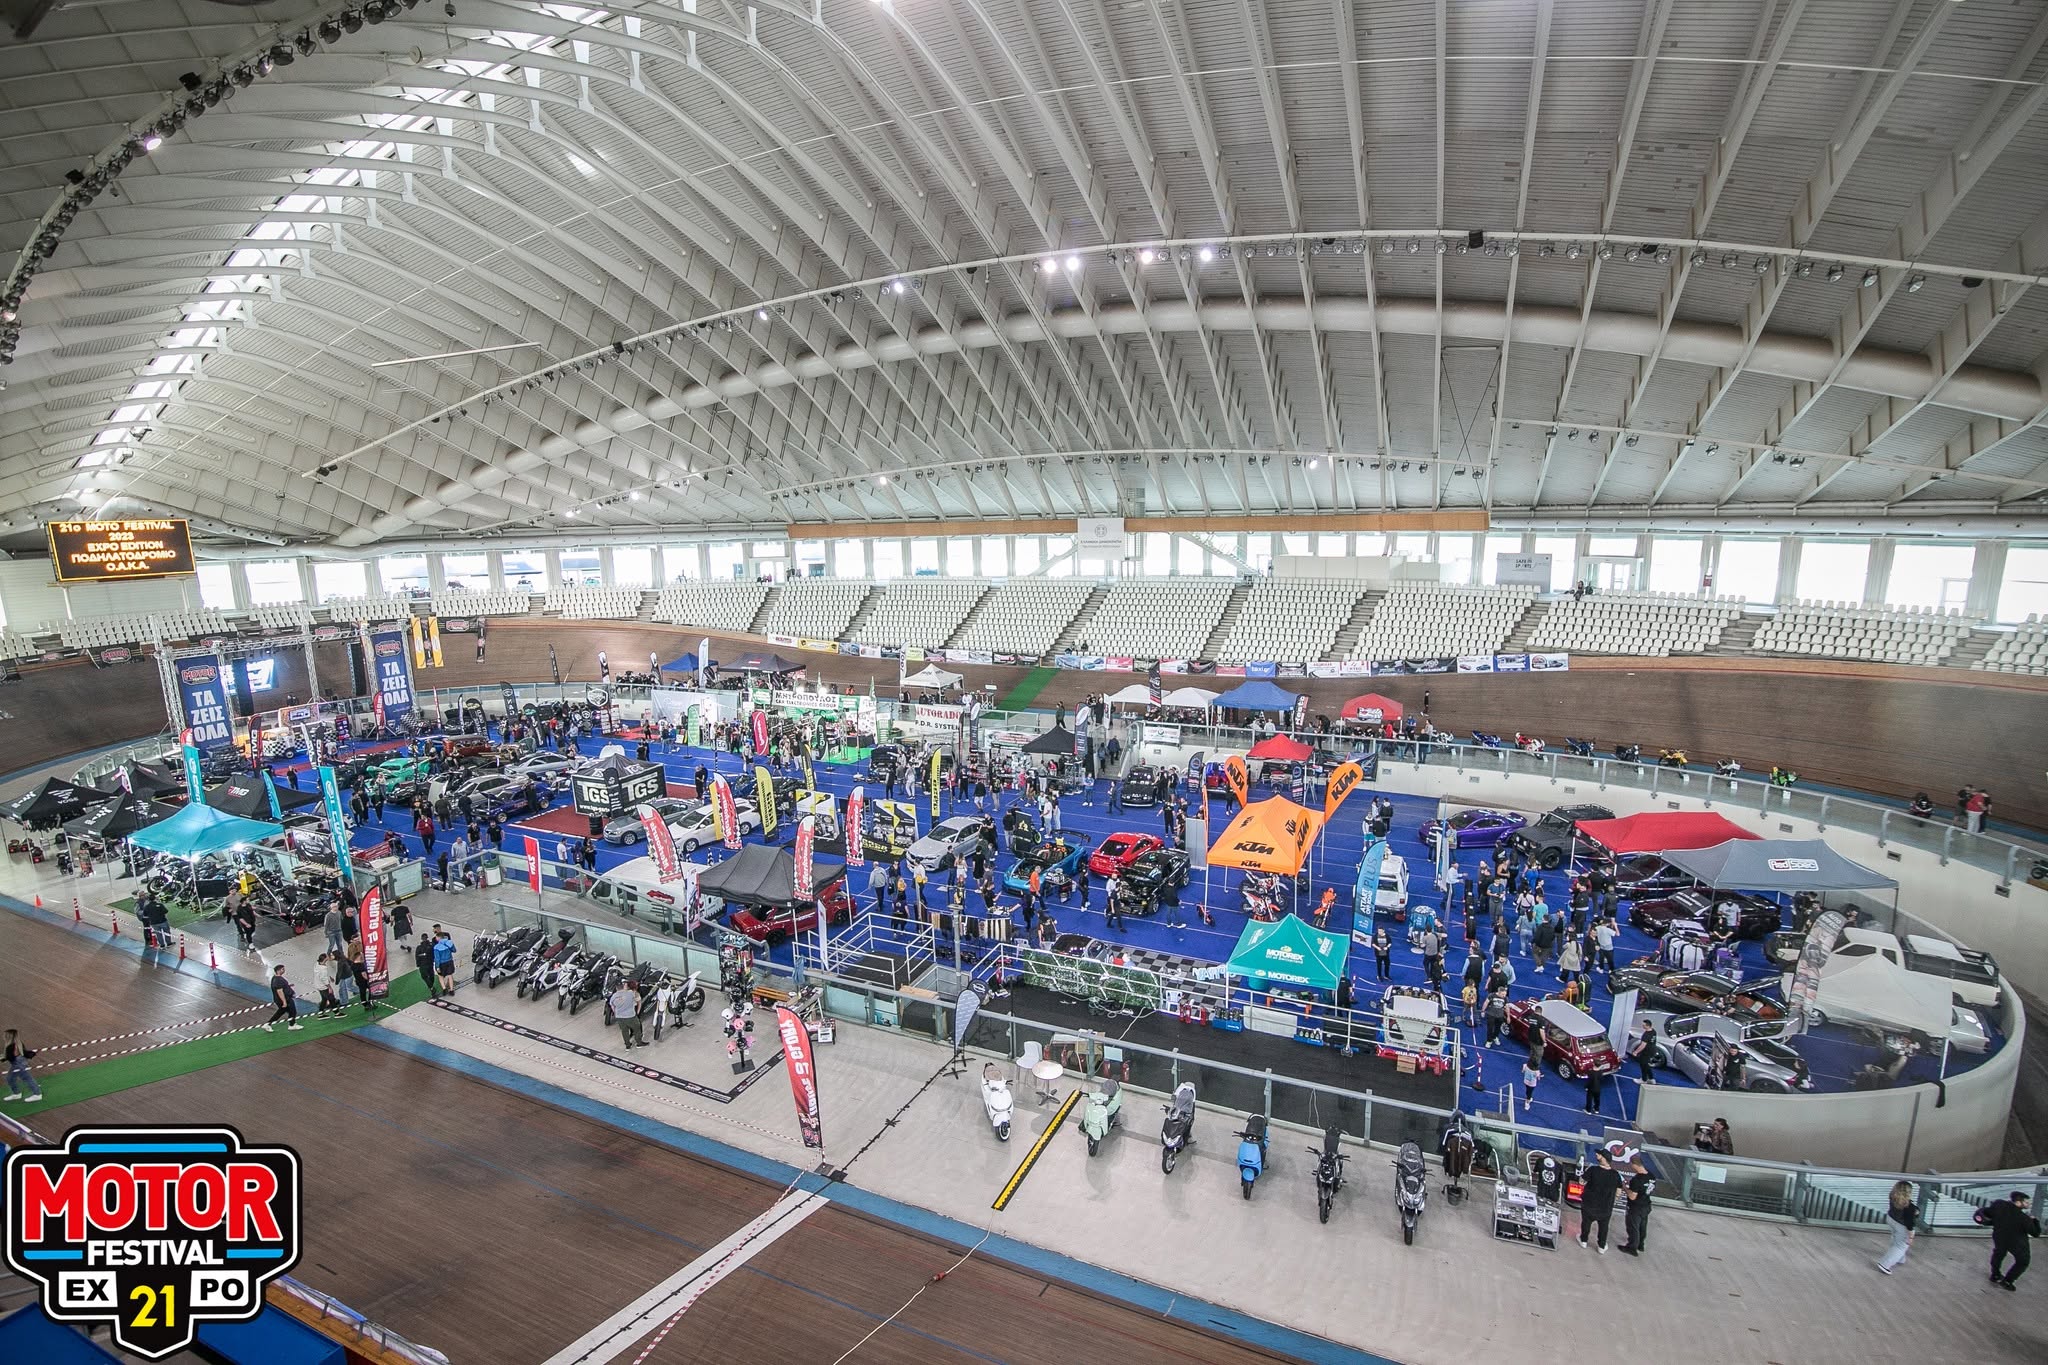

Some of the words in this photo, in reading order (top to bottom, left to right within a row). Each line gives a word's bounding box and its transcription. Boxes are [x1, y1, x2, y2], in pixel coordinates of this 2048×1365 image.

[86, 522, 120, 532] MOTO
[123, 521, 174, 531] FESTIVAL
[108, 532, 134, 541] 2023
[87, 543, 119, 552] EXPO
[121, 541, 164, 551] EDITION
[71, 550, 176, 563] ΠΟΔΗΛΑΤΟΔΡΟΜΙΟ
[183, 667, 216, 679] MOTOR
[382, 675, 407, 691] ΖΕΙΣ
[384, 690, 410, 706] ΟΛΑ
[191, 706, 226, 726] ΖΕΙΣ
[193, 722, 229, 742] ΟΛΑ
[577, 781, 610, 803] TGS
[622, 772, 659, 801] TGS
[1331, 769, 1358, 800] KTM
[1297, 818, 1309, 851] KTM
[1233, 841, 1275, 856] KTM
[1241, 860, 1261, 868] KTM
[1364, 858, 1377, 888] PLUS
[369, 897, 381, 930] GLORY
[368, 931, 379, 943] TO
[1266, 949, 1305, 960] MOTOREX
[1268, 971, 1310, 984] MOTOREX
